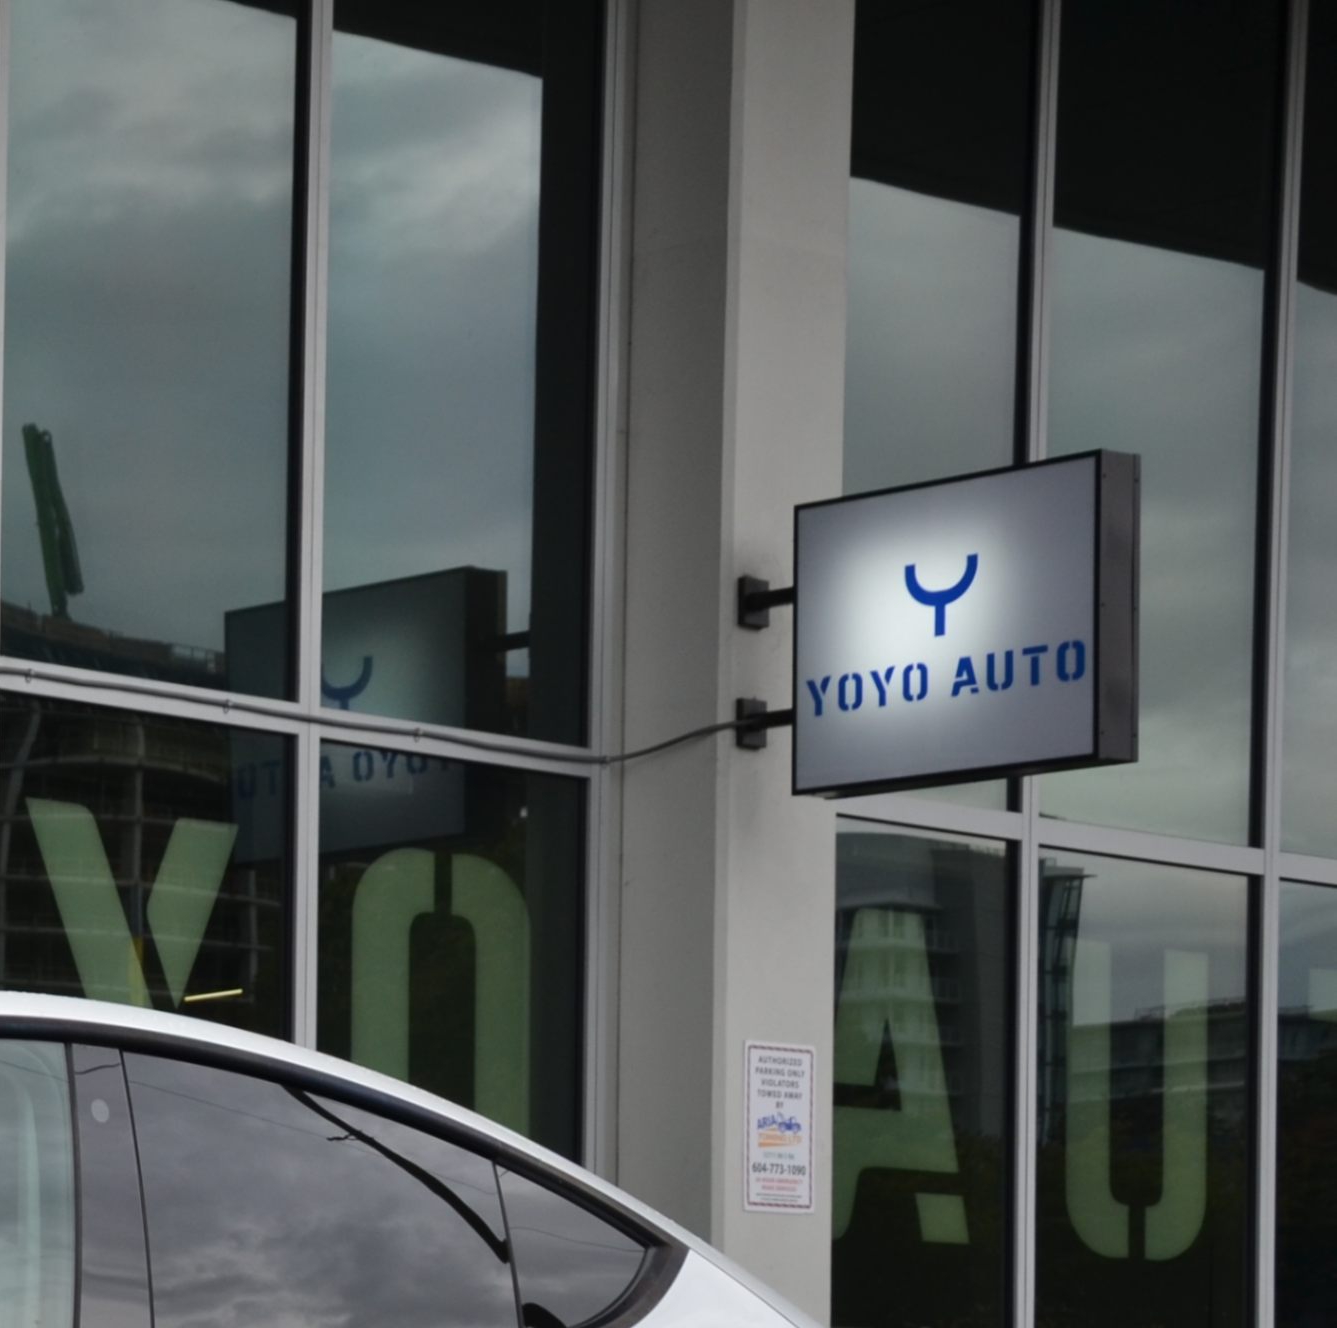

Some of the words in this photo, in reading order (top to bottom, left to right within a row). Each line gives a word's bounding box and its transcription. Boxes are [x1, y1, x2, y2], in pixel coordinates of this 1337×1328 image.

[806, 662, 929, 717] YOYO
[950, 639, 1086, 698] AUTO
[757, 1056, 803, 1067] AUTHORIZED
[755, 1066, 786, 1077] PARKING
[787, 1069, 805, 1078] ONLY
[760, 1078, 800, 1089] VIOLATORS
[757, 1089, 783, 1099] TOWED
[784, 1091, 803, 1100] AWAY
[751, 1161, 806, 1176] 604-773-1090
